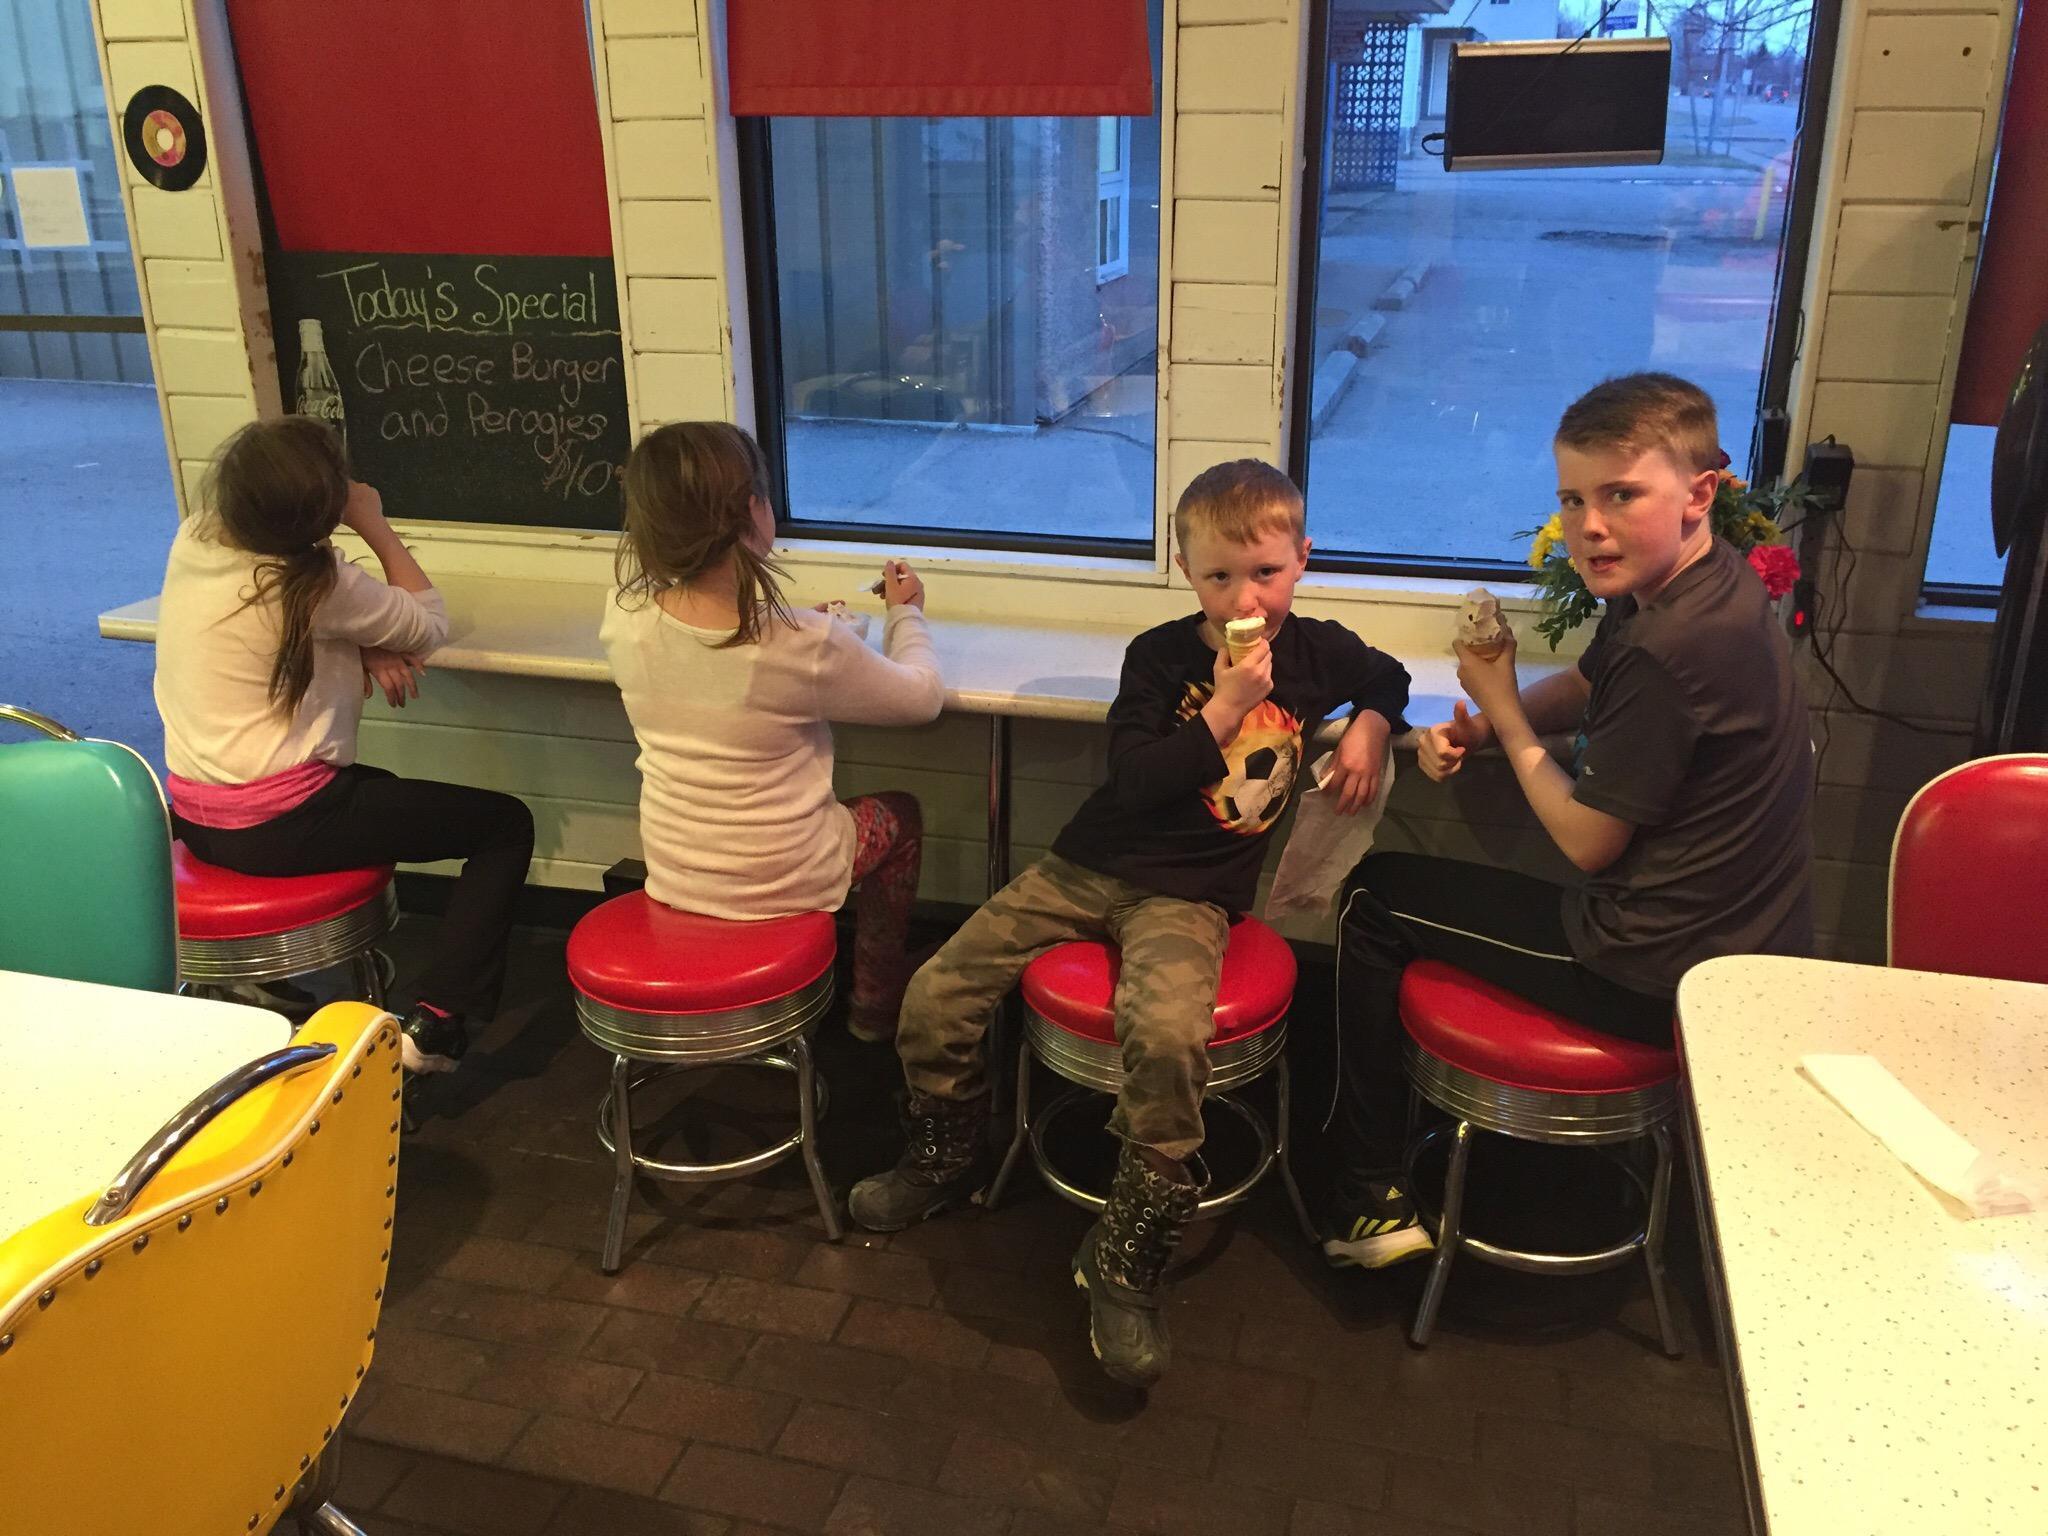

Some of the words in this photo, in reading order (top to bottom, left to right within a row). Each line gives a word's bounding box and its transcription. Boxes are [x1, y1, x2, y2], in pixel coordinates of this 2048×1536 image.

[317, 262, 458, 332] Today's
[473, 264, 597, 335] Special
[355, 342, 495, 394] Cheese
[511, 341, 617, 407] Burger
[380, 392, 449, 440] and
